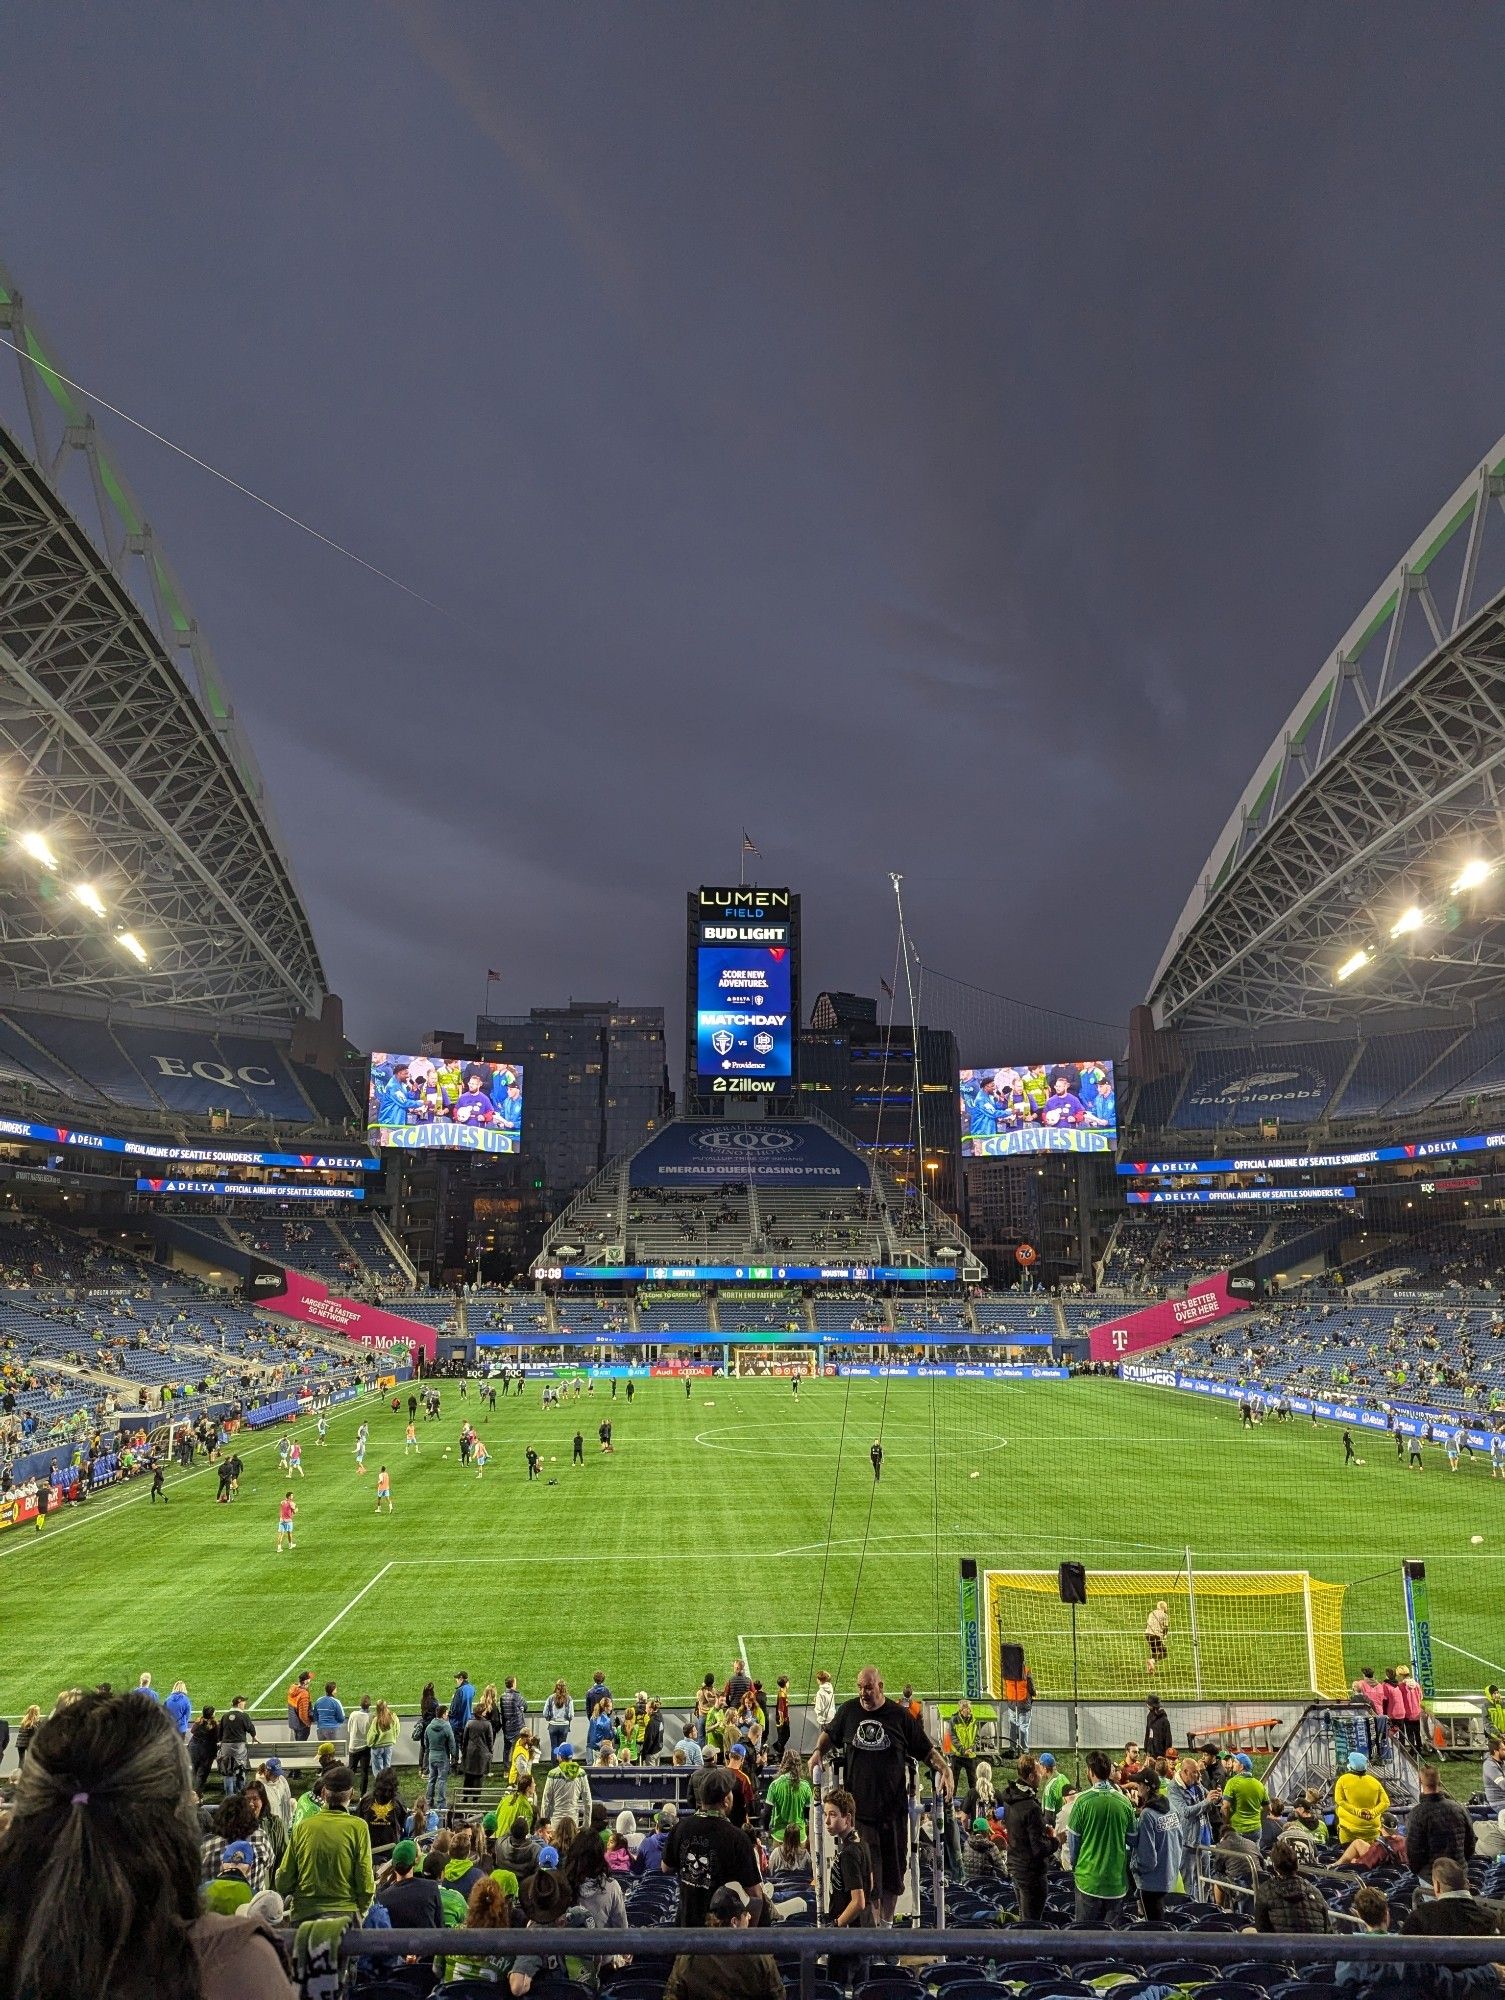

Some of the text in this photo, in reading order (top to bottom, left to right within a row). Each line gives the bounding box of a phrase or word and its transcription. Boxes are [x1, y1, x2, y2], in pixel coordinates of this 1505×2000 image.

[700, 891, 789, 906] LUMEN
[725, 908, 764, 918] FIELD
[704, 927, 785, 940] BUD LIGHT
[722, 970, 765, 979] SCORE NEW
[718, 979, 769, 988] ADVENTURES.
[701, 1014, 787, 1026] MATCHDAY
[732, 1061, 766, 1069] Providence
[150, 1055, 276, 1089] EQC
[728, 1078, 775, 1092] Zillow
[755, 1123, 794, 1136] QUEEN
[78, 1135, 103, 1147] DELTA
[391, 1123, 510, 1151] SCARVES UP
[713, 1132, 786, 1150] EQC
[985, 1127, 1106, 1156] SCARVES UP
[125, 1142, 146, 1155] OFFICIAL
[146, 1147, 170, 1158] AIRLINE
[170, 1149, 181, 1158] OF
[181, 1150, 212, 1160] SEATTLE
[212, 1152, 252, 1163] SOUNDERS
[1427, 1141, 1458, 1153] DELTA
[328, 1158, 363, 1168] DELTA
[1162, 1162, 1198, 1171] DELTA
[1234, 1159, 1267, 1169] OFFICIAL
[1267, 1158, 1298, 1168] AIRLINE
[1299, 1157, 1309, 1167] OF
[1309, 1155, 1341, 1166] SEATTLE
[1341, 1152, 1370, 1164] SOUNDERS
[658, 1166, 715, 1174] EMERALD
[716, 1166, 756, 1174] QUEEN
[805, 1167, 841, 1175] PITCH
[178, 1183, 215, 1192] DELTA
[224, 1185, 252, 1193] OFFICIAL
[252, 1186, 277, 1195] AIRLINE
[278, 1187, 286, 1195] OF
[286, 1187, 313, 1196] SEATTLE
[313, 1188, 345, 1197] SOUNDERS
[1421, 1183, 1435, 1193] EQC
[1165, 1192, 1200, 1200] DELTA
[1209, 1191, 1236, 1200] OFFICIAL
[1237, 1190, 1261, 1199] AIRLINE
[1262, 1190, 1271, 1198] OF
[1271, 1189, 1299, 1198] SEATTLE
[1299, 1189, 1333, 1197] SOUNDERS
[1019, 1248, 1033, 1260] 76
[736, 1269, 743, 1278] 0
[1173, 1292, 1217, 1313] IT'S BETTER
[301, 1296, 330, 1311] LARGEST
[333, 1306, 361, 1322] FASTEST
[1175, 1308, 1198, 1322] OVER
[1199, 1301, 1220, 1315] HERE
[308, 1306, 318, 1315] 5G
[317, 1309, 349, 1326] NETWORK
[374, 1335, 416, 1350] Mobile
[1112, 1330, 1128, 1351] T
[466, 1370, 484, 1378] EQC
[505, 1369, 522, 1378] EQC
[1123, 1364, 1176, 1387] SOUNDERS
[1369, 1415, 1385, 1426] Allstate
[966, 1620, 978, 1698] SOUNDERS
[1418, 1621, 1435, 1697] SOUNDERS
